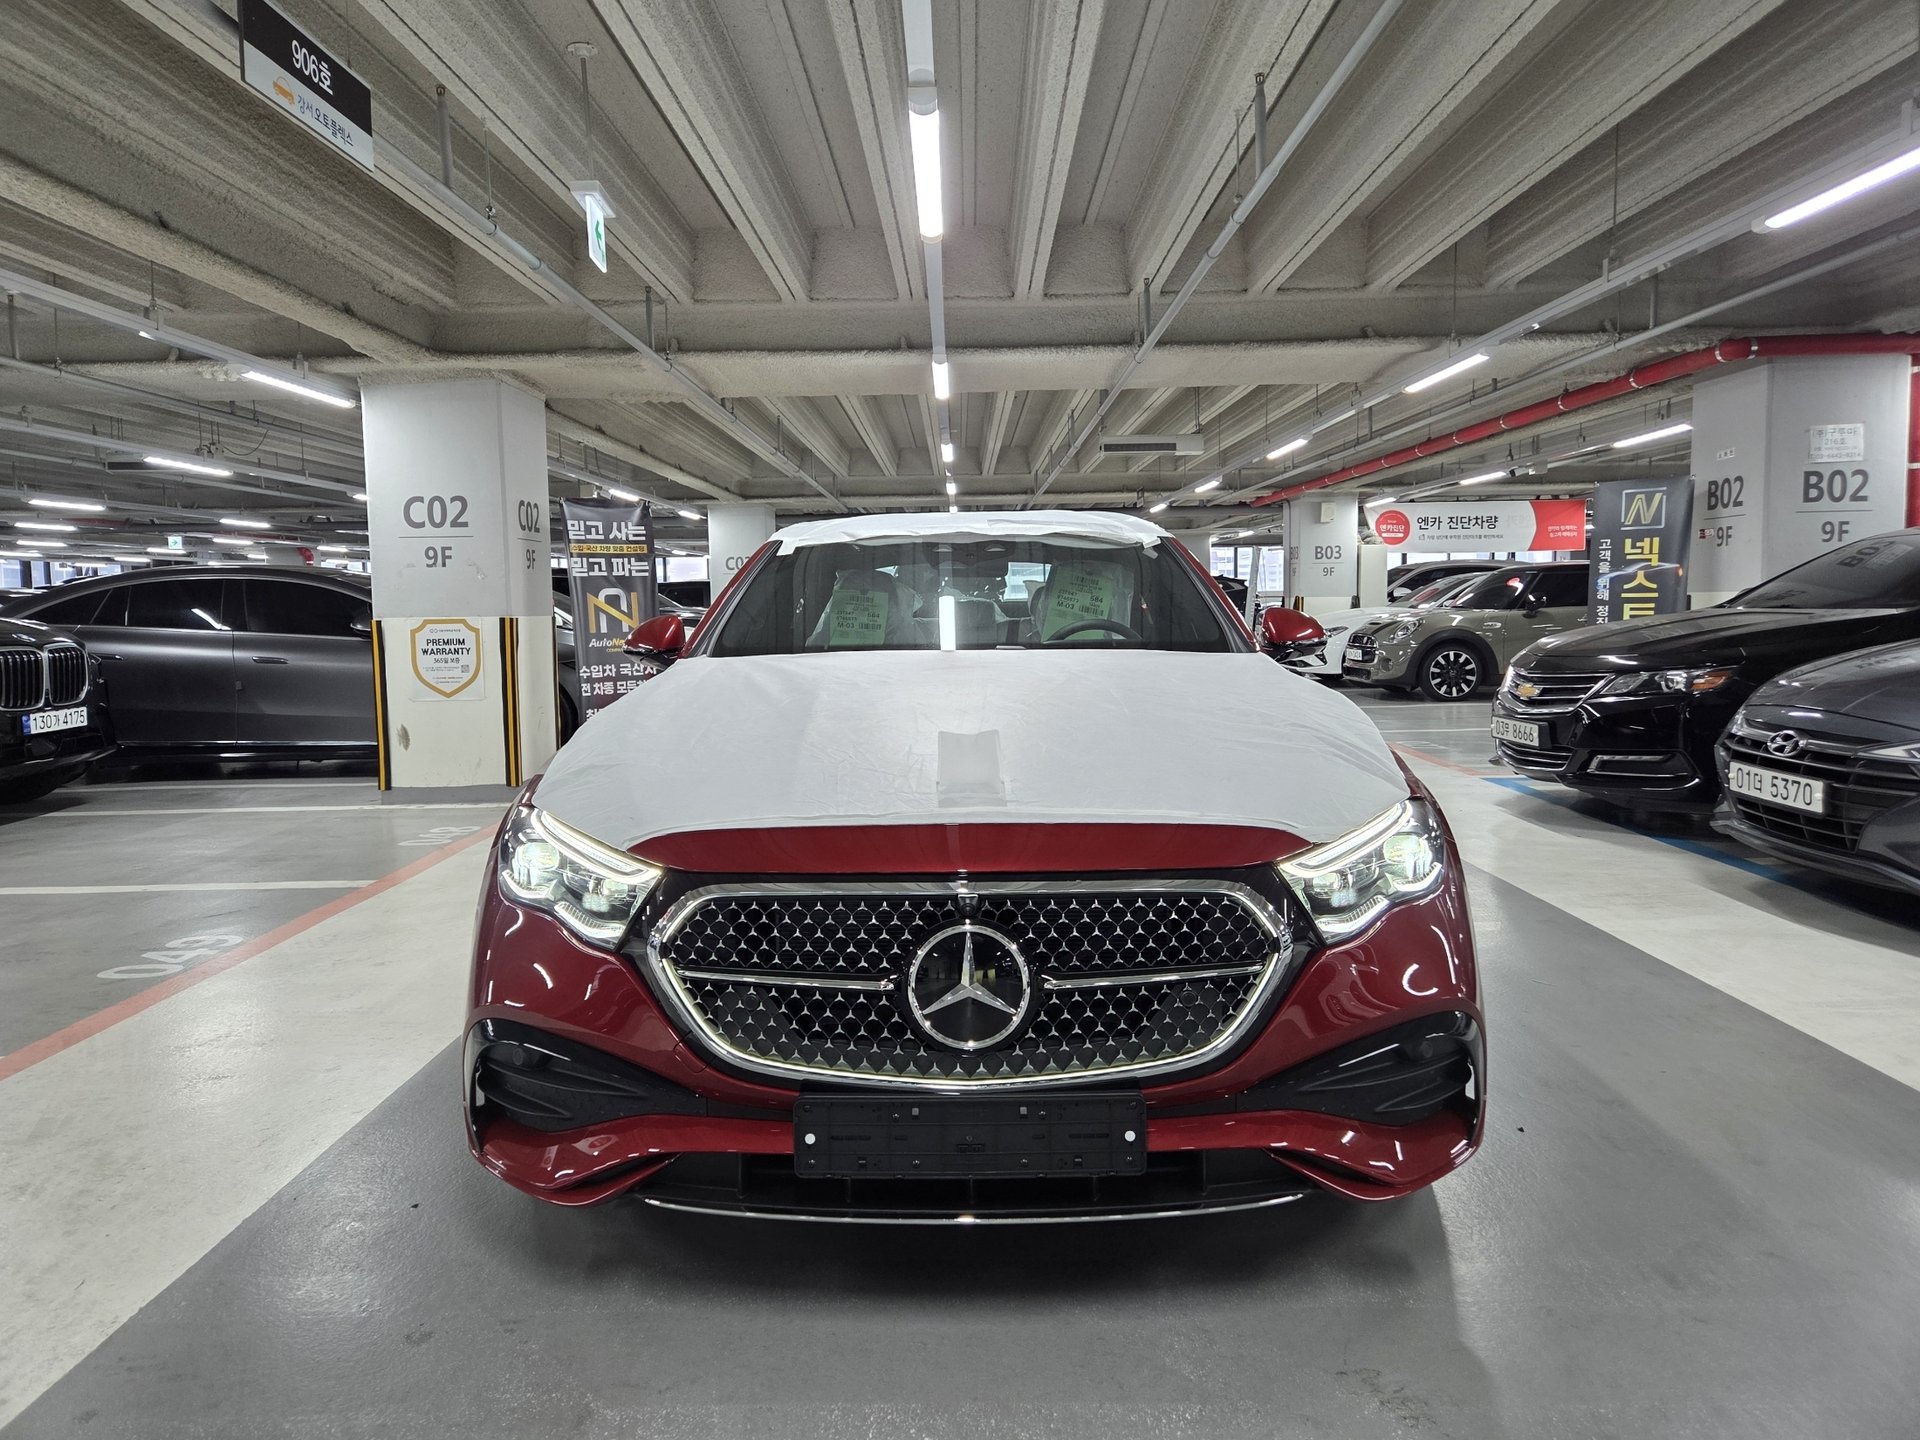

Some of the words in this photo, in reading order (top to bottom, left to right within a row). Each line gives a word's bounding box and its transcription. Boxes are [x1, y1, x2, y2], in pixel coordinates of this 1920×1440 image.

[292, 40, 333, 95] 906호
[1707, 475, 1744, 511] B02
[1803, 469, 1870, 503] B02
[403, 495, 469, 529] C02
[518, 499, 541, 534] C02
[567, 520, 604, 541] 믿고
[609, 520, 646, 541] 사는
[1379, 524, 1405, 532] 엔카진단
[1417, 516, 1442, 530] 엔카
[1447, 515, 1499, 530] 진단차량
[1821, 521, 1850, 543] 9F
[1716, 525, 1733, 547] 9F
[424, 546, 453, 568] 9F
[525, 548, 536, 570] 9F
[1315, 545, 1342, 560] B03
[1597, 539, 1612, 573] 고객을
[570, 557, 608, 577] 믿고
[612, 557, 649, 577] 파는
[1322, 567, 1335, 577] 9F
[1057, 601, 1075, 609] M-03
[421, 647, 471, 655] WARRANTY
[426, 638, 466, 647] PREMIUM
[589, 638, 625, 648] AutoNe
[579, 664, 617, 678] 수입차
[581, 683, 591, 696] 전
[593, 681, 614, 695] 차종
[63, 710, 86, 726] 4175
[1513, 724, 1534, 742] 8666
[1737, 767, 1763, 793] 01더
[1770, 775, 1813, 806] 5370
[397, 826, 481, 846] 048
